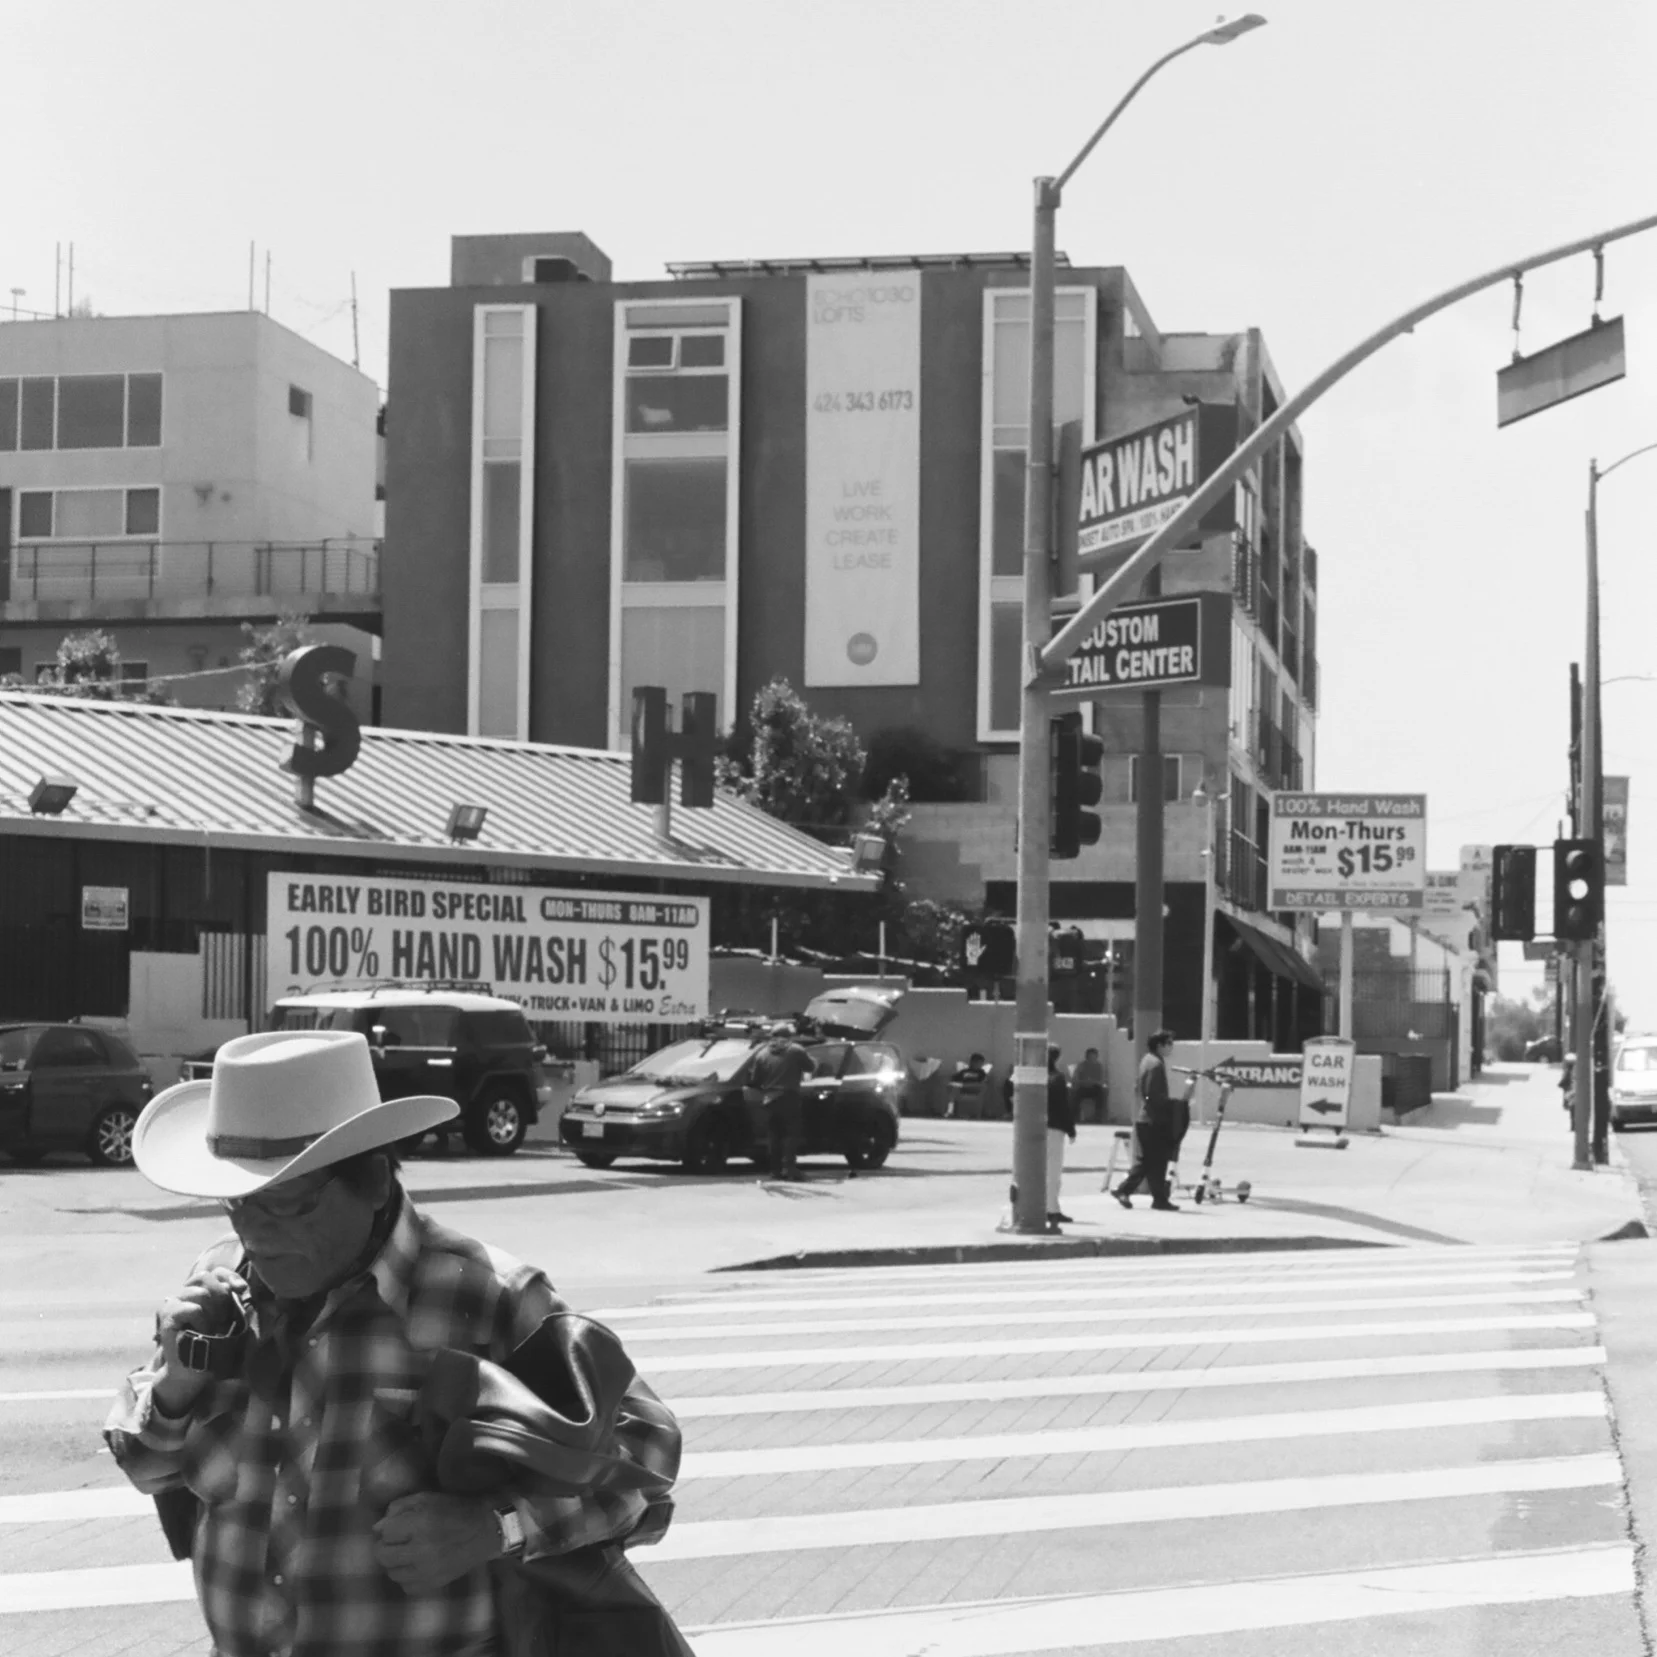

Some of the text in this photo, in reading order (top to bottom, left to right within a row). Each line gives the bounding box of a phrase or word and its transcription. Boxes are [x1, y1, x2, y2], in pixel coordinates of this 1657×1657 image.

[813, 306, 866, 325] LOFTS
[846, 391, 874, 412] 343
[879, 390, 913, 411] 6173
[1080, 420, 1194, 522] AR WASH
[842, 479, 882, 498] LIVE
[833, 504, 893, 522] WORK
[824, 528, 899, 547] CREATE
[833, 552, 893, 570] LEASE
[1064, 645, 1194, 686] TAIL CENTER
[1276, 799, 1421, 814] 100% Hand Wash
[1290, 821, 1406, 840] Mon-Thurs
[287, 883, 697, 925] EARLY BIRD SPECIAL MON-THURS 8AM-11AM
[1286, 892, 1409, 905] DETAIL EXPERTS
[285, 925, 689, 991] 100% HAND WASH $15.99
[530, 995, 571, 1011] TRUCK
[579, 996, 606, 1012] VAN
[610, 998, 619, 1012] &
[623, 998, 654, 1013] LIMO
[1311, 1054, 1345, 1069] CAR
[1215, 1066, 1299, 1083] ENTRANC
[1307, 1076, 1346, 1088] WASH
